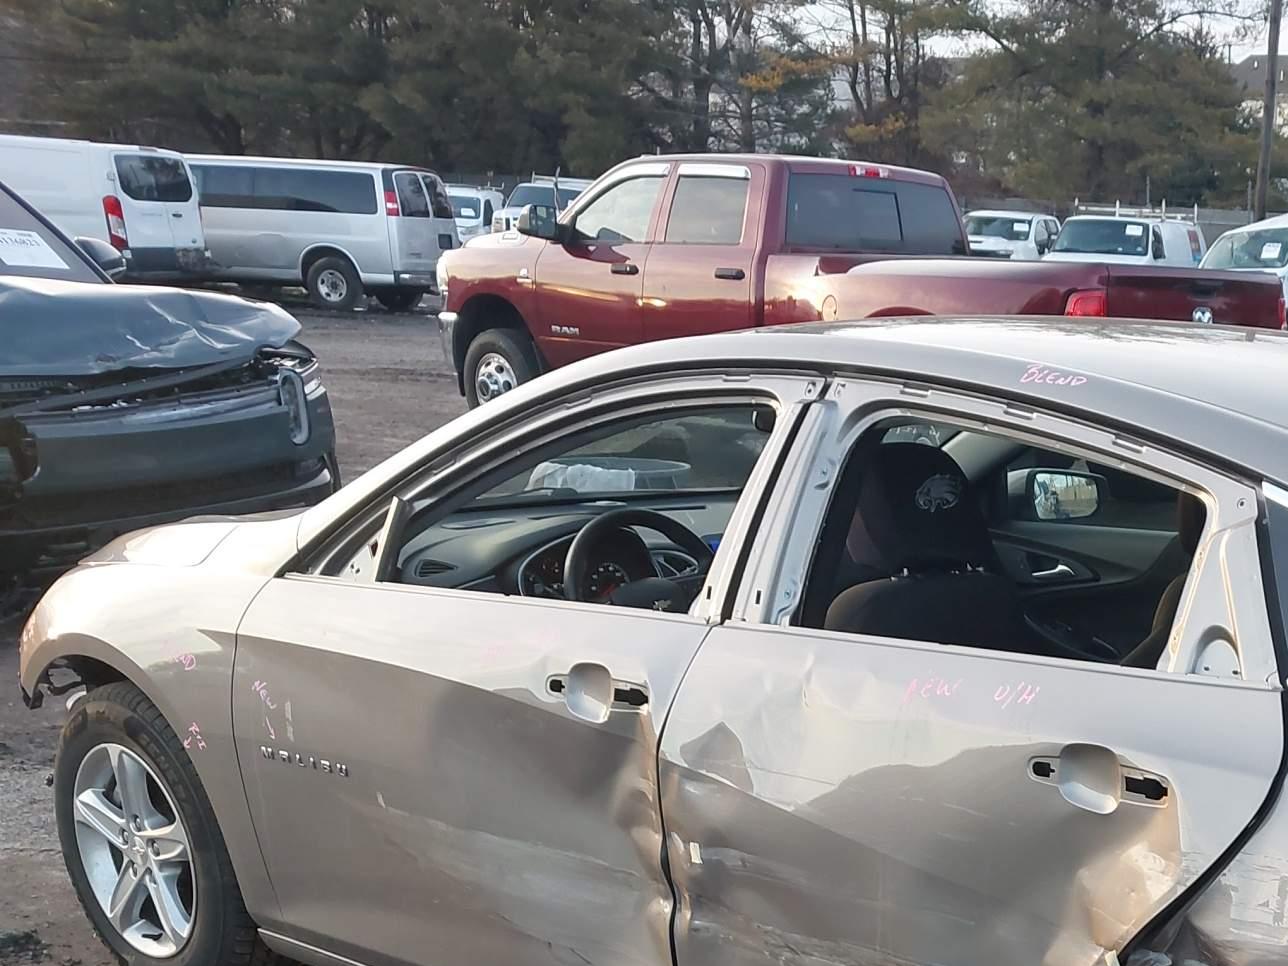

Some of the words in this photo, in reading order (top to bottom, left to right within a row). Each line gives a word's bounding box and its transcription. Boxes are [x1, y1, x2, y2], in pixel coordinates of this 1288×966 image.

[551, 325, 580, 336] RAM
[1020, 362, 1088, 386] BLEND
[260, 746, 349, 777] MALIBU
